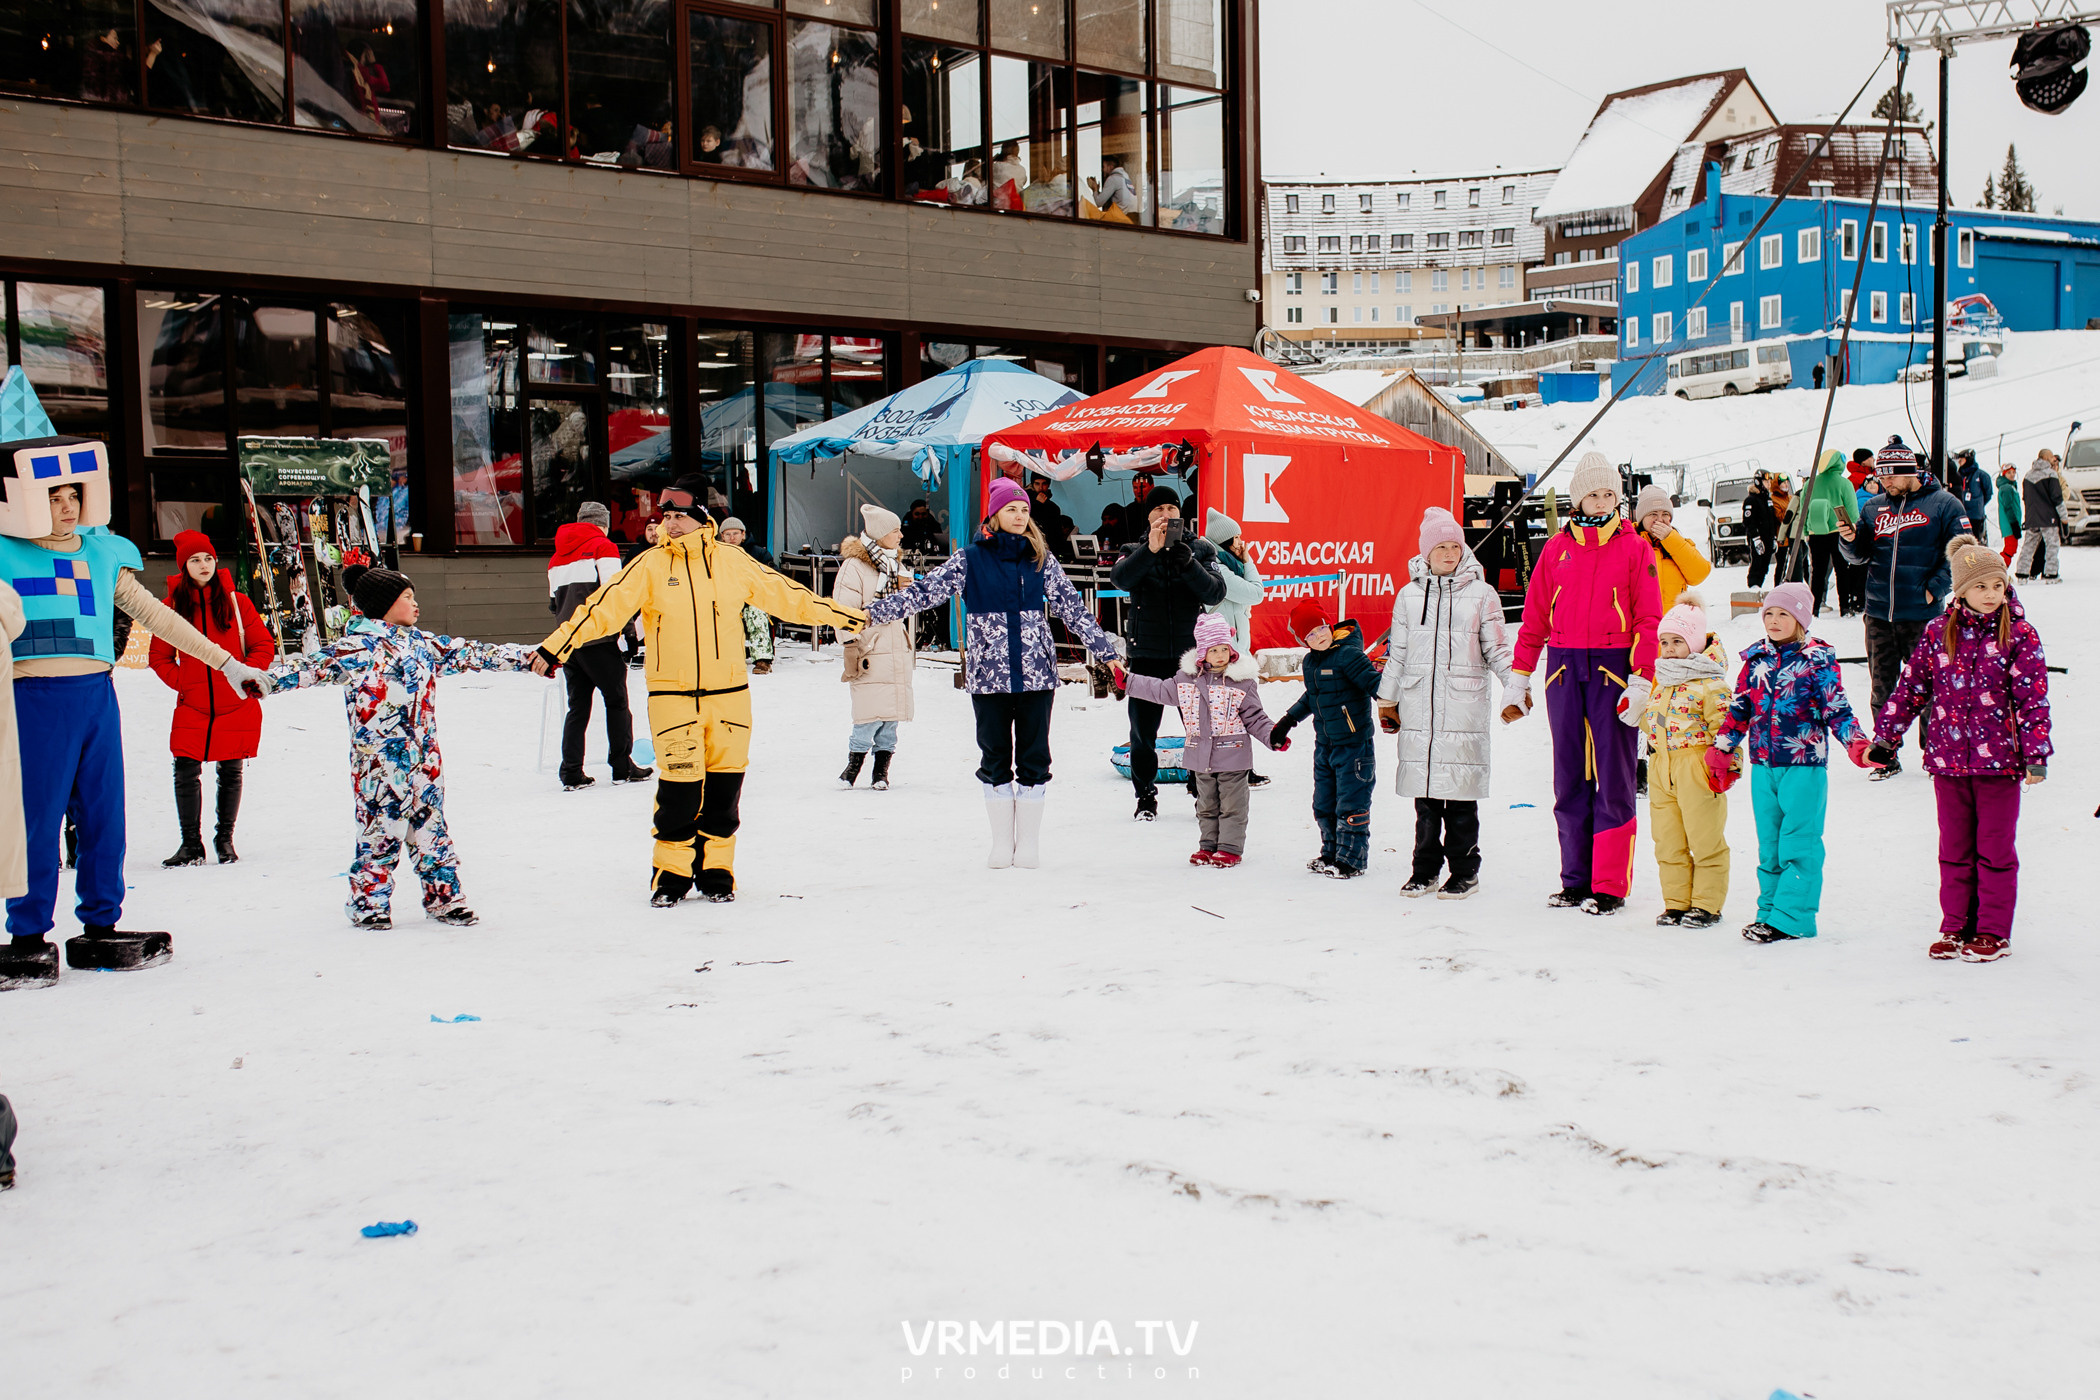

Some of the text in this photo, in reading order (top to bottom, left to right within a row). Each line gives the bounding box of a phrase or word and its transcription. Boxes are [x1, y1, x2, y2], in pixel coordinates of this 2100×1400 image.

[1004, 399, 1048, 412] 300
[1073, 403, 1188, 419] КУЗБАССКАЯ
[1243, 403, 1362, 429] КУЗБАССКАЯ
[1874, 510, 1928, 534] Russia
[1242, 541, 1374, 565] КУЗБАССКАЯ
